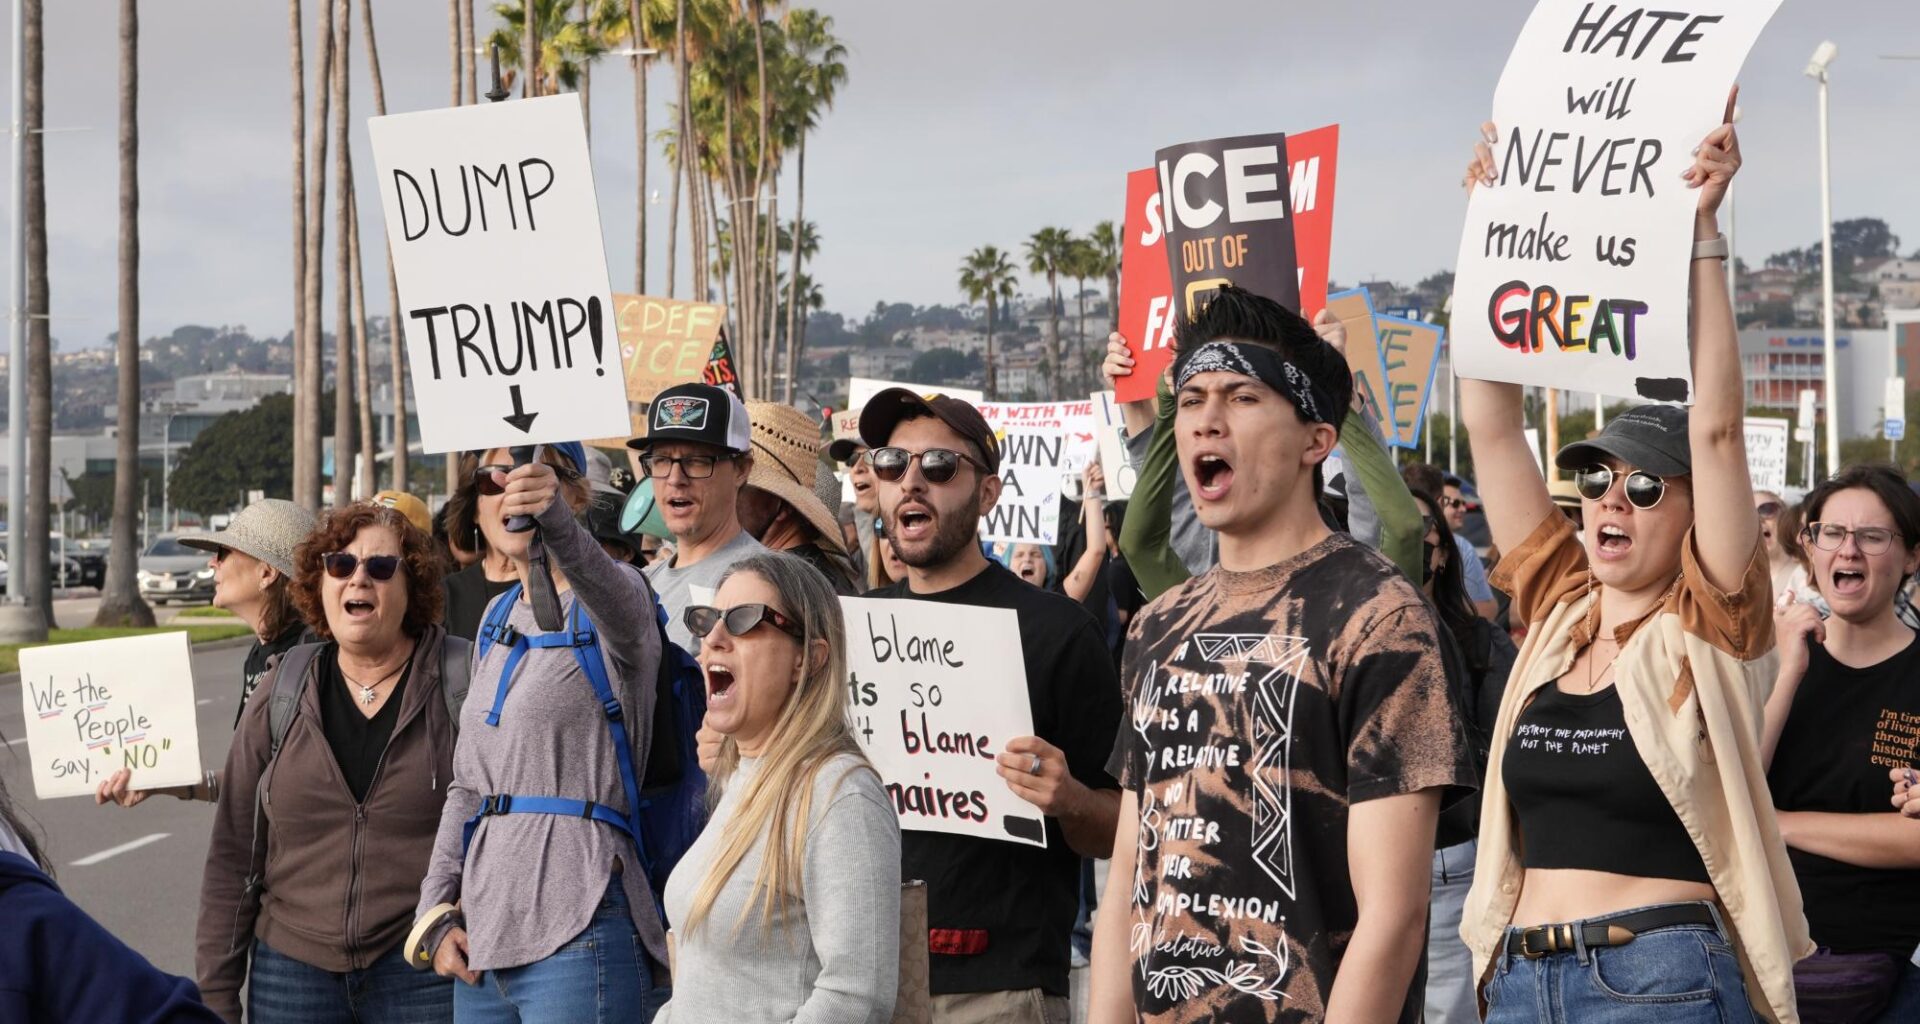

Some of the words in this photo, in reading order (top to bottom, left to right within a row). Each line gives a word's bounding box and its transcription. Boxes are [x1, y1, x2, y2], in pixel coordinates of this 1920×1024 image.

[1562, 2, 1724, 63] HATE
[1566, 77, 1636, 120] will
[1500, 126, 1662, 198] NEVER
[393, 157, 554, 241] DUMP
[1159, 145, 1284, 234] ICE
[1182, 238, 1215, 273] OUT
[1221, 234, 1248, 268] OF
[1485, 211, 1571, 262] make
[1596, 235, 1636, 267] us
[1488, 280, 1648, 360] GREAT
[410, 296, 604, 380] TRUMP!
[1007, 405, 1056, 420] WITH
[1063, 403, 1093, 416] THE
[1001, 469, 1024, 496] A
[867, 612, 964, 668] blame
[1174, 641, 1190, 661] A
[29, 675, 67, 712] We
[73, 673, 112, 704] the
[910, 683, 942, 708] so
[1165, 672, 1251, 696] RELATIVE
[73, 705, 152, 748] People
[1161, 708, 1180, 731] IS
[1187, 709, 1199, 732] A
[1876, 719, 1889, 729] of
[1881, 709, 1897, 720] I'm
[900, 708, 995, 756] blame
[1518, 724, 1552, 738] DESTROY
[1555, 728, 1572, 738] THE
[1573, 729, 1626, 740] PATRIARCHY
[1521, 738, 1539, 749] NOT
[1545, 740, 1563, 753] THE
[1572, 742, 1609, 754] PLANET
[51, 758, 99, 784] say.
[1161, 744, 1240, 770] RELATIVE
[1164, 782, 1183, 807] NO
